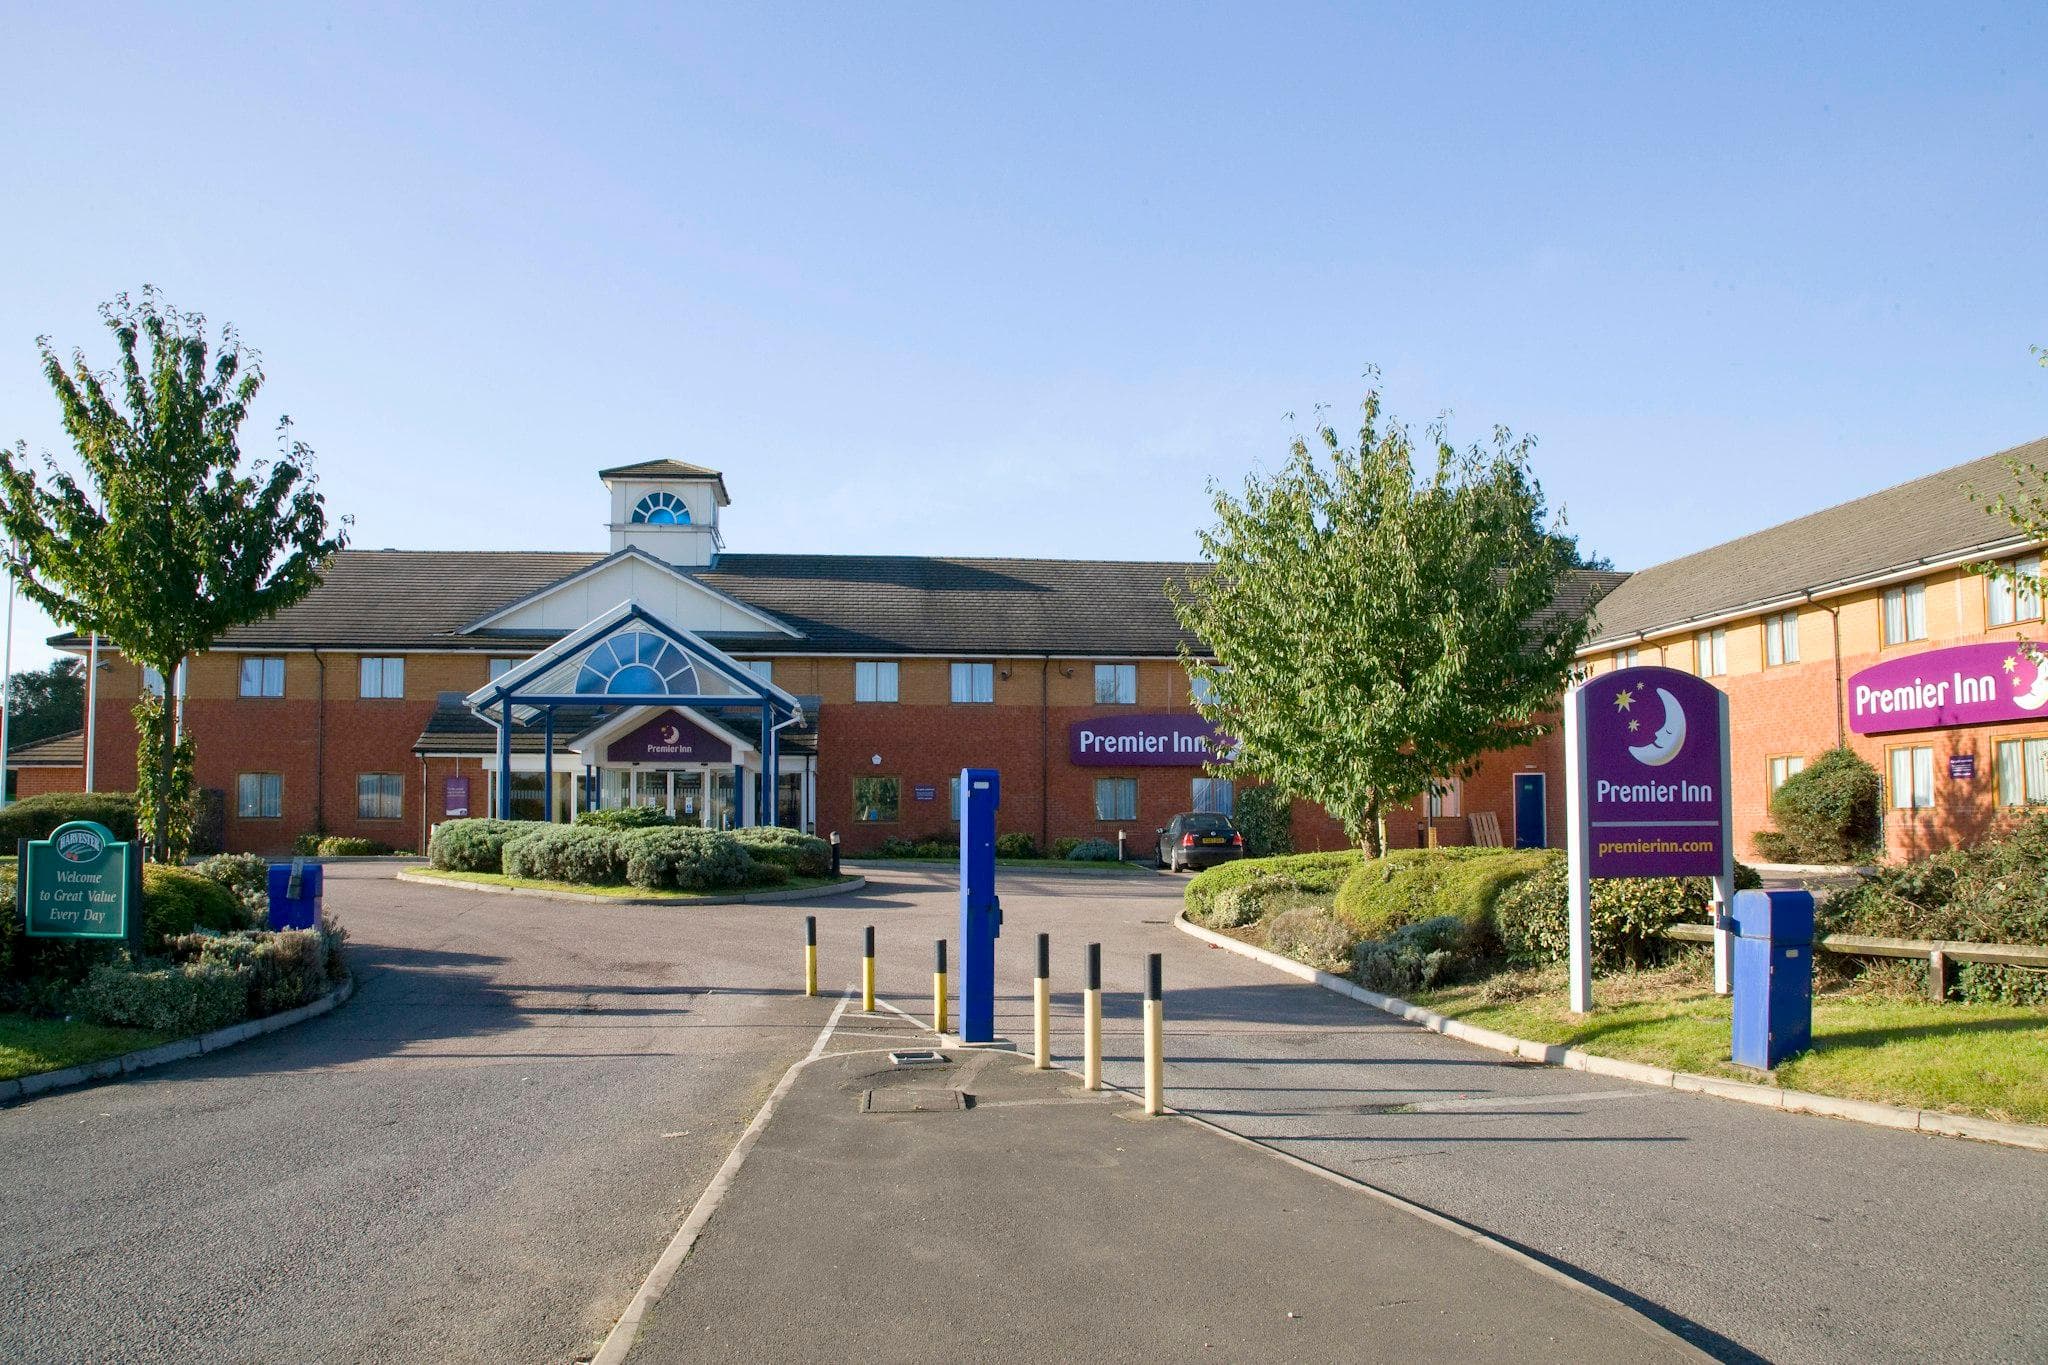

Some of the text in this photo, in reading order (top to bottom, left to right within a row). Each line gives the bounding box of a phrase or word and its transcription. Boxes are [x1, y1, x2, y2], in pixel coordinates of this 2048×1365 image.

[1856, 672, 1996, 716] Premier Inn
[647, 744, 692, 753] Premier Inn
[1080, 731, 1207, 753] Premier Inn
[1597, 780, 1712, 802] Premier Inn
[60, 832, 101, 852] HARVESTER
[1599, 838, 1713, 857] premierinn.com
[57, 871, 102, 883] Welcome
[40, 889, 117, 903] to Great Value
[50, 908, 106, 924] Every Day
